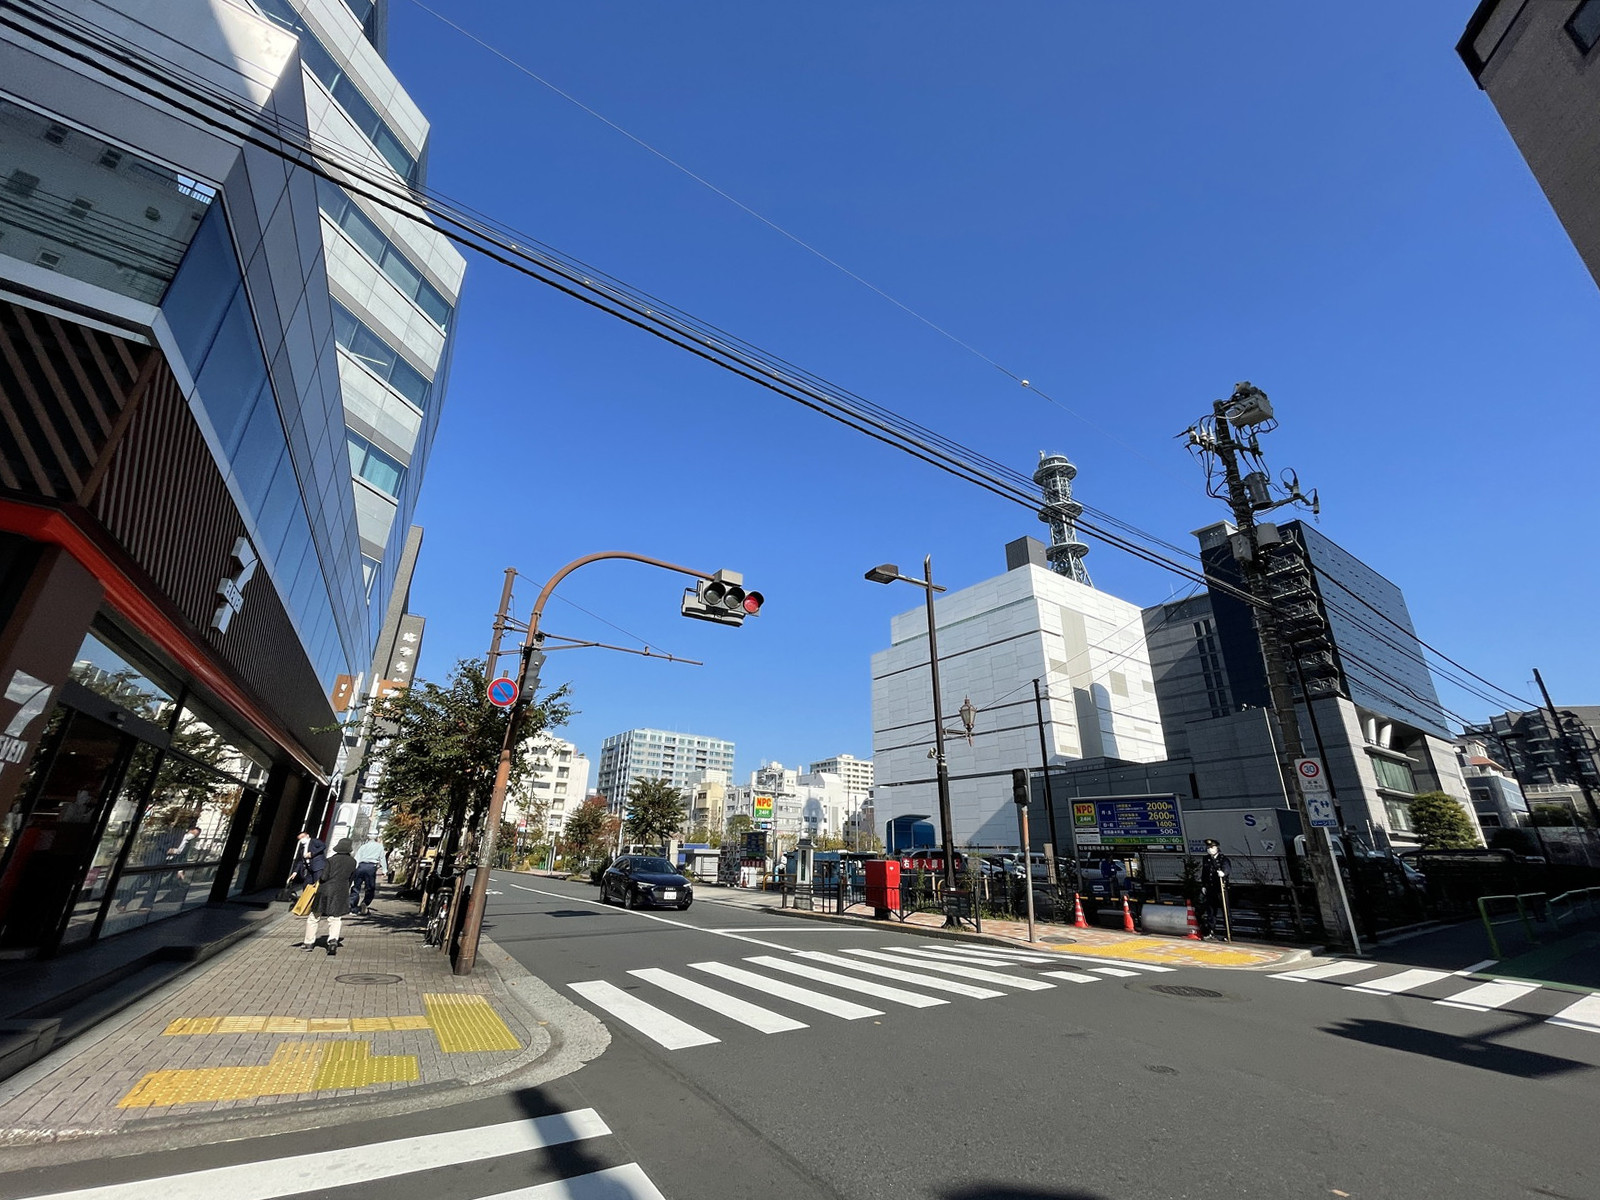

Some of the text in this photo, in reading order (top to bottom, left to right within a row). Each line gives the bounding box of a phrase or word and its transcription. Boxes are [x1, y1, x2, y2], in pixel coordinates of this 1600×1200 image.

[211, 536, 259, 635] 7
[3, 669, 55, 738] 7
[1304, 765, 1315, 774] 30
[757, 797, 772, 807] NPC
[1075, 805, 1093, 815] NPC
